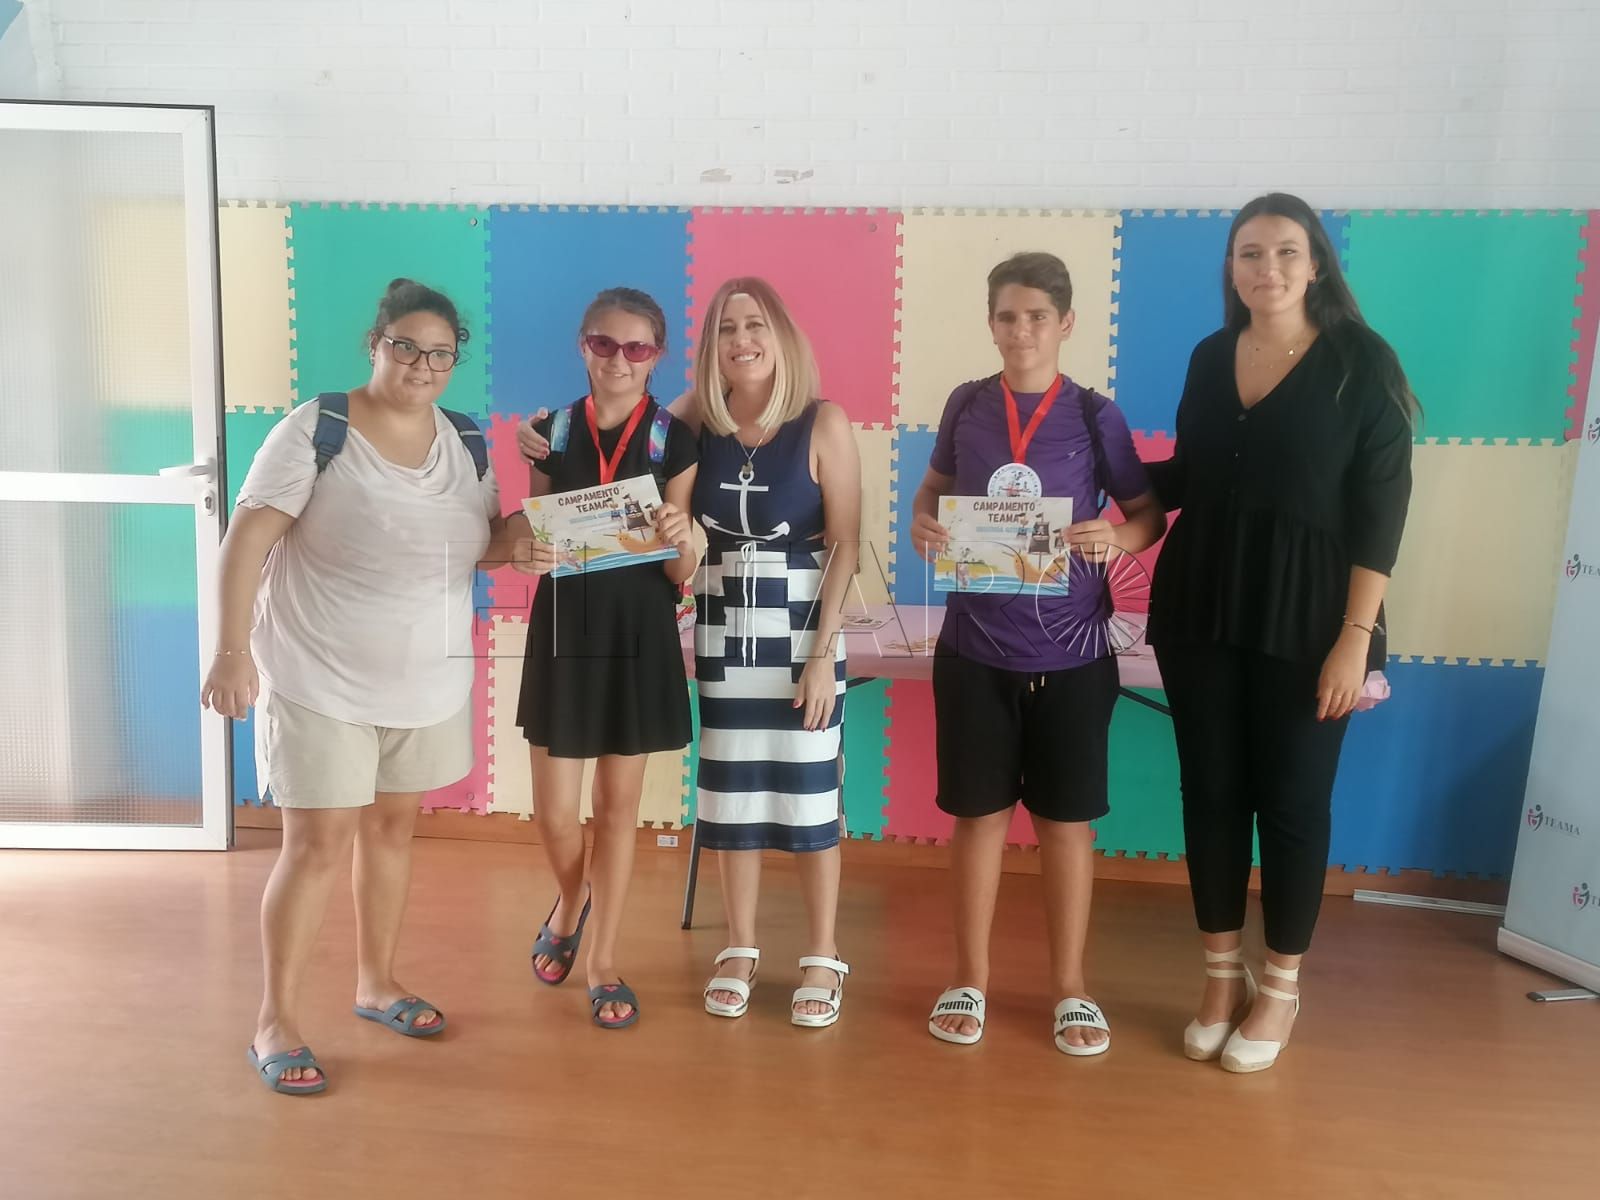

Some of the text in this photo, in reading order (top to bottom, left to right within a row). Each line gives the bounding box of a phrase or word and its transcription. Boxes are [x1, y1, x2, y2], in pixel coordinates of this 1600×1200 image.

[558, 487, 620, 506] CAMPAMENTO
[576, 500, 609, 513] TEAMA
[973, 501, 1036, 511] CAMPAMENTO
[988, 513, 1020, 523] TEAMA
[1545, 816, 1582, 835] TEAMA
[937, 1000, 973, 1012] PUMA
[1059, 1011, 1095, 1025] PUMA
